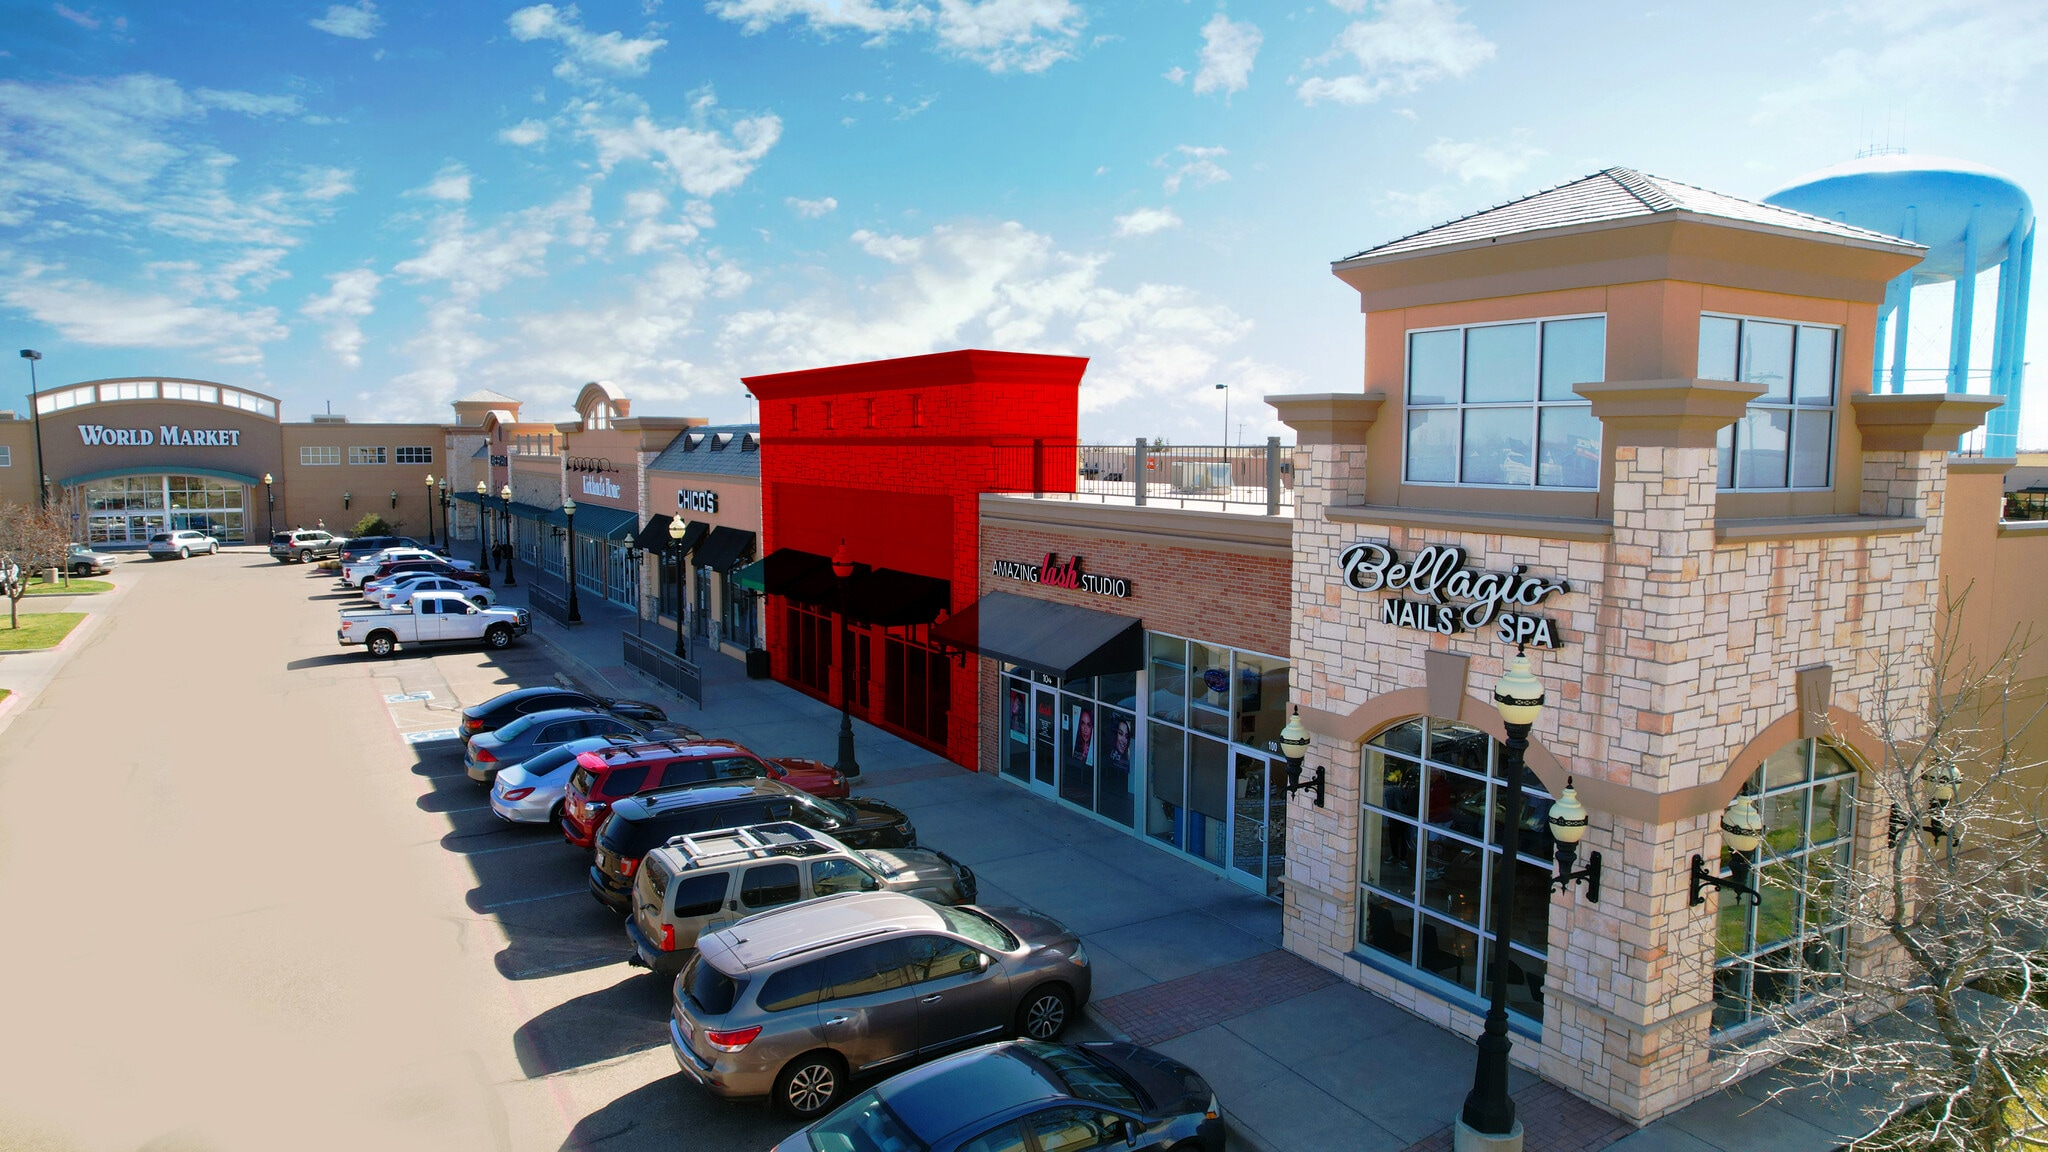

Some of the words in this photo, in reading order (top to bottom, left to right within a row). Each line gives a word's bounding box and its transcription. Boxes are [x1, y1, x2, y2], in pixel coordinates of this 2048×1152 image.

[77, 425, 154, 446] WORLD
[159, 425, 240, 446] MARKET
[677, 489, 715, 514] CHICO'S
[991, 560, 1038, 583] AMAZING
[1040, 552, 1080, 590] lash
[1081, 574, 1126, 598] STUDIO
[1338, 542, 1570, 629] Bellagio
[1382, 598, 1455, 636] NAILS
[1497, 613, 1554, 649] SPA
